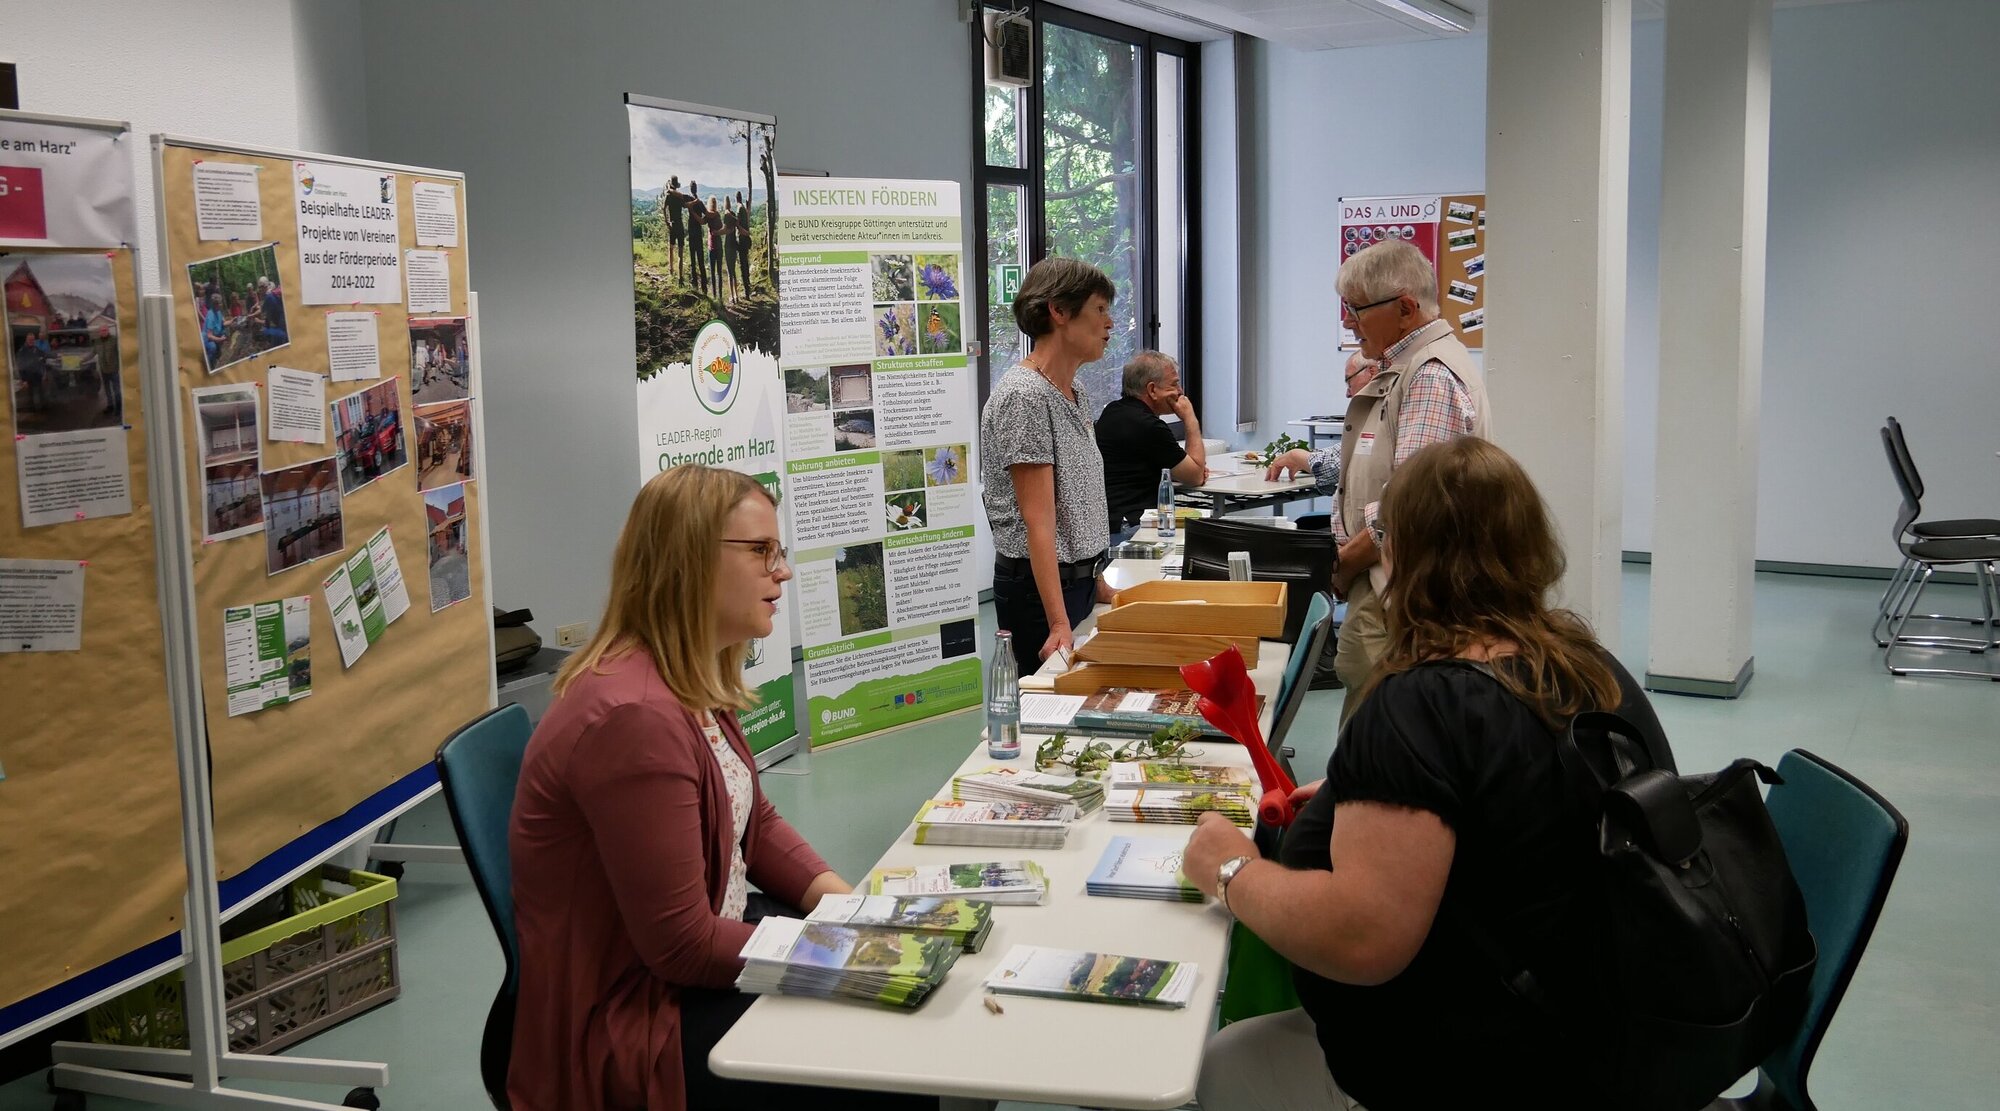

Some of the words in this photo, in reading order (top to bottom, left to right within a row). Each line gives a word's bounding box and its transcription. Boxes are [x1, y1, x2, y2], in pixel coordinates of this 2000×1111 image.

[14, 141, 35, 151] am
[40, 140, 76, 154] Harz"
[793, 190, 865, 206] INSEKTEN
[872, 187, 937, 206] FÖRDERN
[301, 200, 359, 218] Beispielhafte
[362, 206, 394, 220] LEADER-
[1345, 207, 1371, 219] DAS
[1376, 207, 1385, 217] A
[1391, 205, 1420, 216] UND
[785, 220, 796, 228] Die
[799, 220, 819, 228] BUND
[822, 219, 861, 229] Kreisgruppe
[864, 219, 896, 229] Göttingen
[898, 220, 933, 228] unterstützt
[302, 225, 341, 242] Projekte
[343, 231, 358, 241] von
[361, 229, 395, 243] Vereinen
[791, 233, 809, 241] berät
[812, 232, 855, 241] verschiedene
[902, 232, 910, 240] im
[912, 232, 943, 240] Landkreis.
[304, 253, 320, 263] aus
[323, 250, 337, 264] der
[340, 252, 397, 268] Förderperiode
[332, 276, 375, 288] 2014-2022
[877, 361, 913, 369] Strukturen
[656, 426, 721, 446] LEADER-Region
[728, 444, 744, 461] am
[749, 438, 775, 457] Harz
[792, 462, 823, 471] Nahrung
[826, 458, 855, 467] anbieten
[803, 473, 845, 481] blütenbesuchende
[826, 529, 850, 537] regionales
[888, 534, 940, 547] Bewirtschaftung
[943, 530, 963, 538] ändern
[808, 642, 855, 658] Grundsätzlich
[916, 646, 939, 655] Minimieren
[809, 661, 838, 670] Reduzieren
[832, 708, 855, 720] BUND
